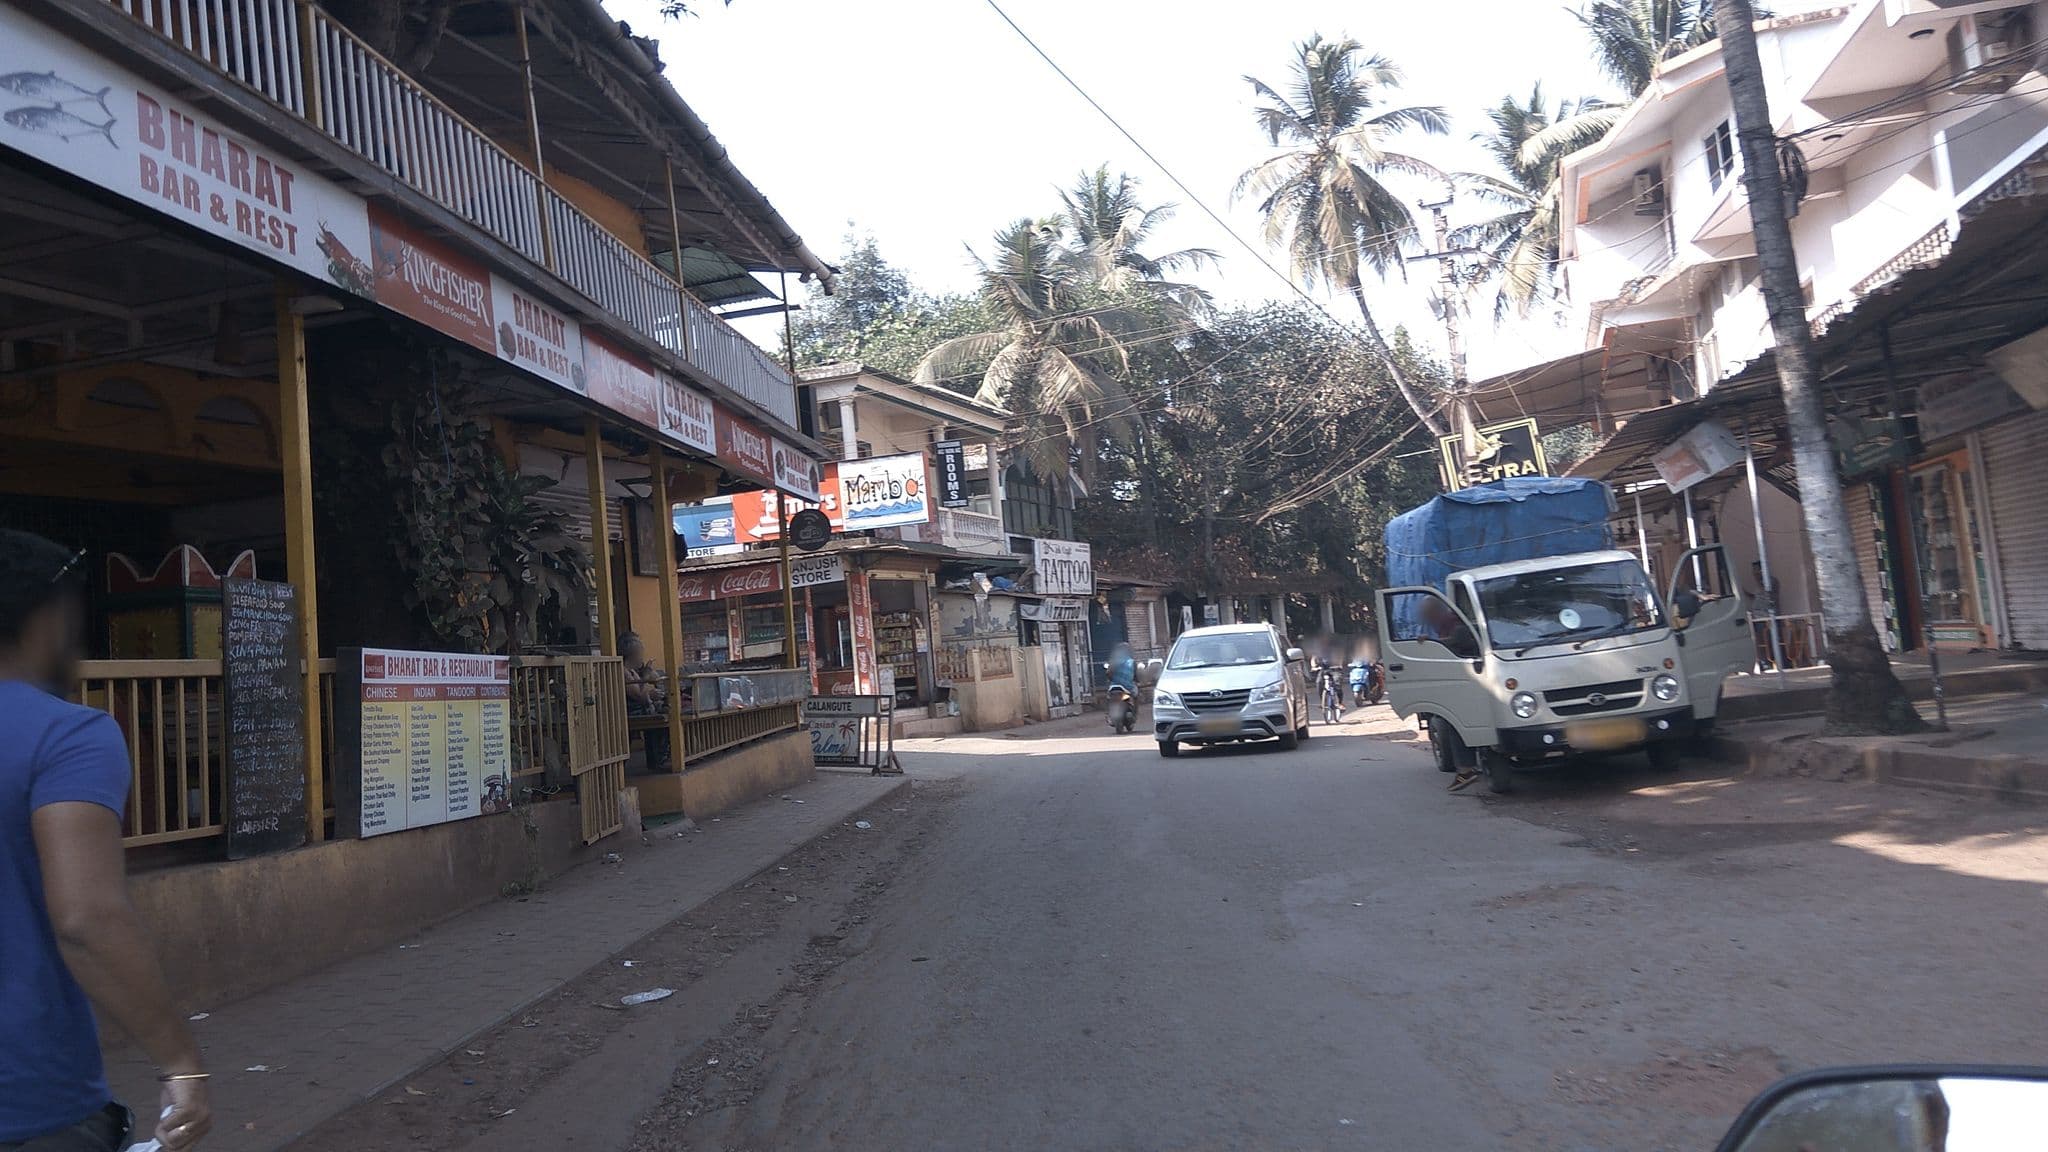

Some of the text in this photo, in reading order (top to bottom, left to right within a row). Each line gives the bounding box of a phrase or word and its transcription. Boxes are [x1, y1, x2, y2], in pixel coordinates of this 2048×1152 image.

[136, 90, 294, 215] BHARAT
[139, 152, 298, 256] BAR & REST
[404, 245, 490, 328] KINGFISHER
[434, 298, 445, 314] King
[450, 307, 463, 321] Good
[462, 312, 477, 327] Times
[513, 293, 566, 350] BHARAT
[517, 333, 538, 364] BAR
[547, 348, 570, 379] REST
[690, 423, 708, 446] REST
[844, 470, 919, 505] Mambo
[945, 454, 960, 500] ROOMS
[792, 570, 832, 585] STORE
[1041, 558, 1090, 595] TATTOO
[1052, 606, 1081, 620] TATTOO
[388, 656, 420, 676] BHARAT
[423, 657, 439, 677] BAR
[441, 658, 447, 677] &
[448, 658, 493, 678] RESTAURANT
[366, 687, 398, 698] CHINESE
[414, 687, 436, 697] INDIAN
[446, 686, 476, 696] TANDOORI
[807, 701, 852, 712] CALANGUTE
